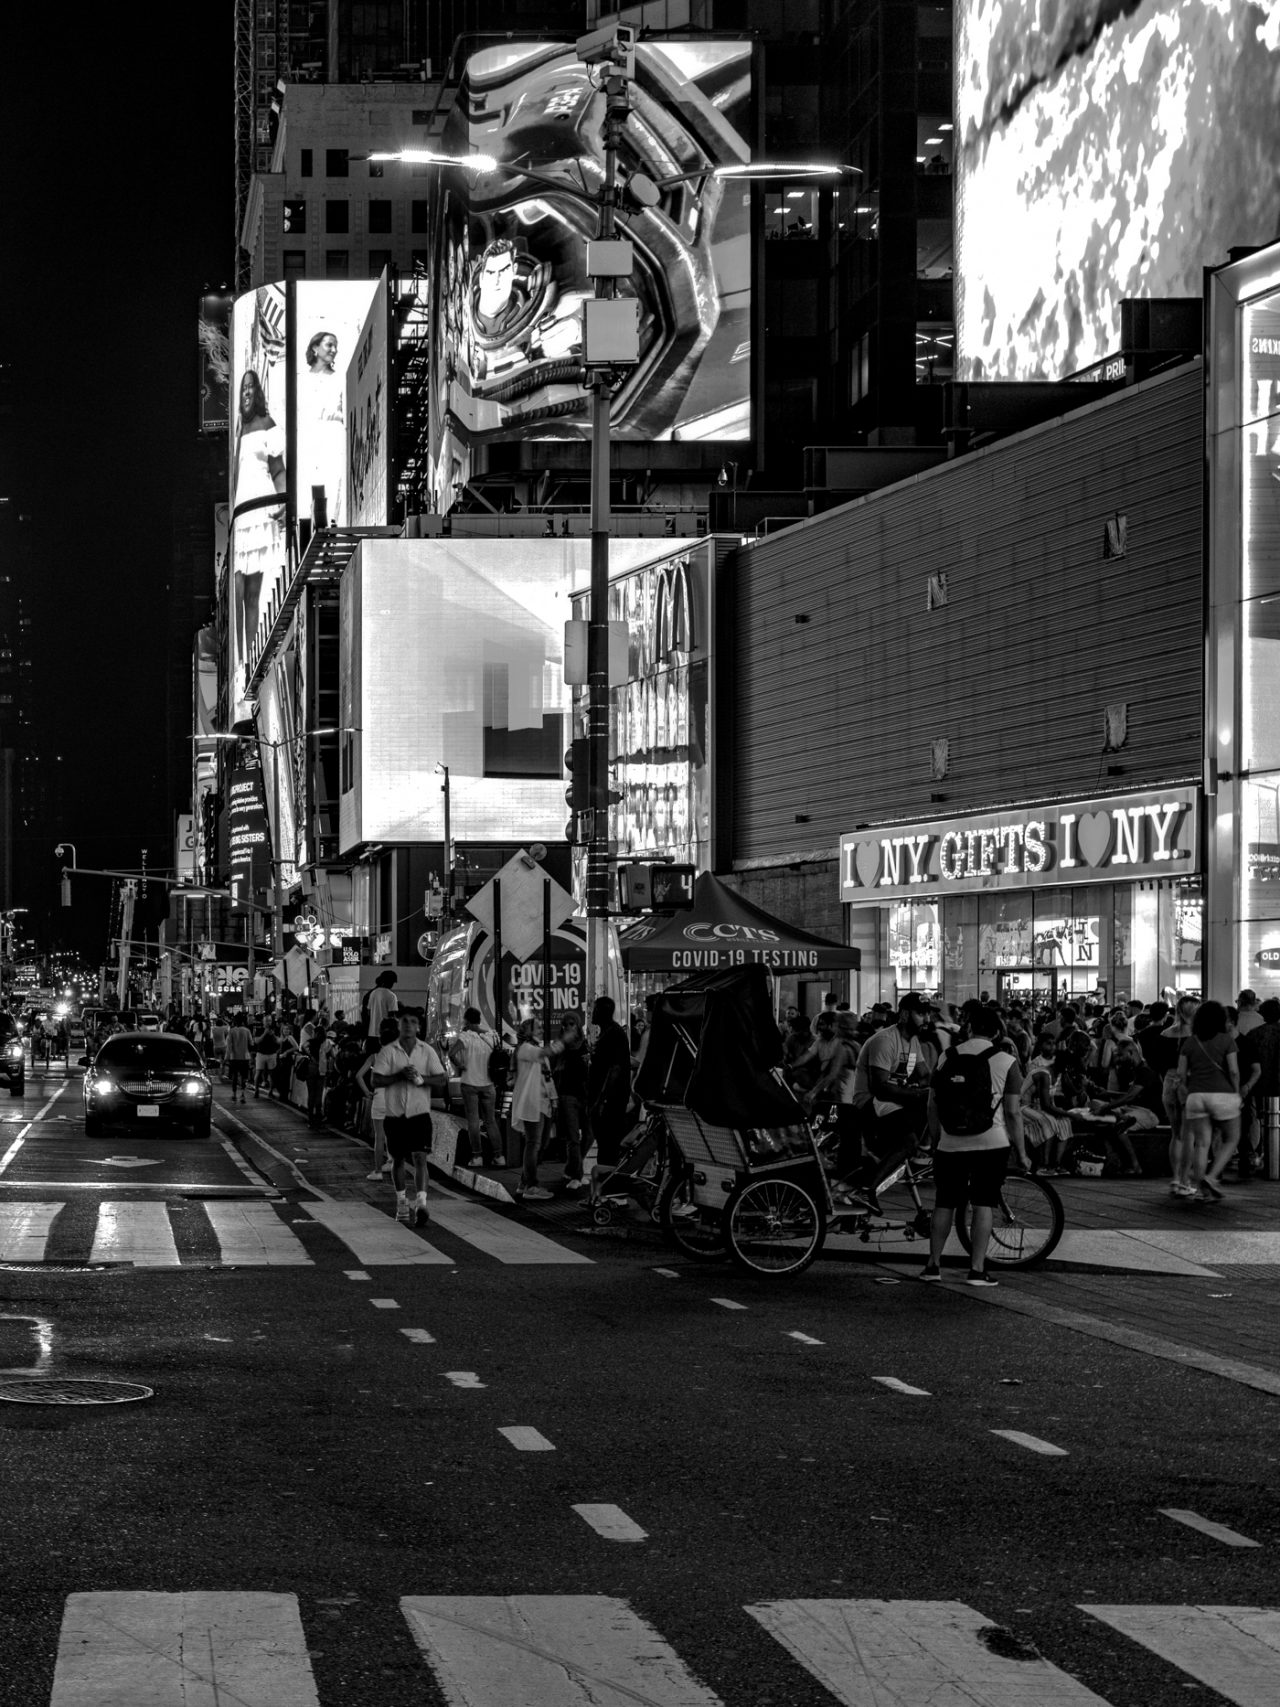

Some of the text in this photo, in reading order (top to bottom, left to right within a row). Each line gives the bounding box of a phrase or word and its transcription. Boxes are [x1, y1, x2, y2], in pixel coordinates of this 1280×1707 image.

[939, 821, 1047, 881] GIFTS
[680, 874, 693, 901] 4
[671, 950, 819, 968] COVID-19 TESTING
[1261, 952, 1280, 961] OLD
